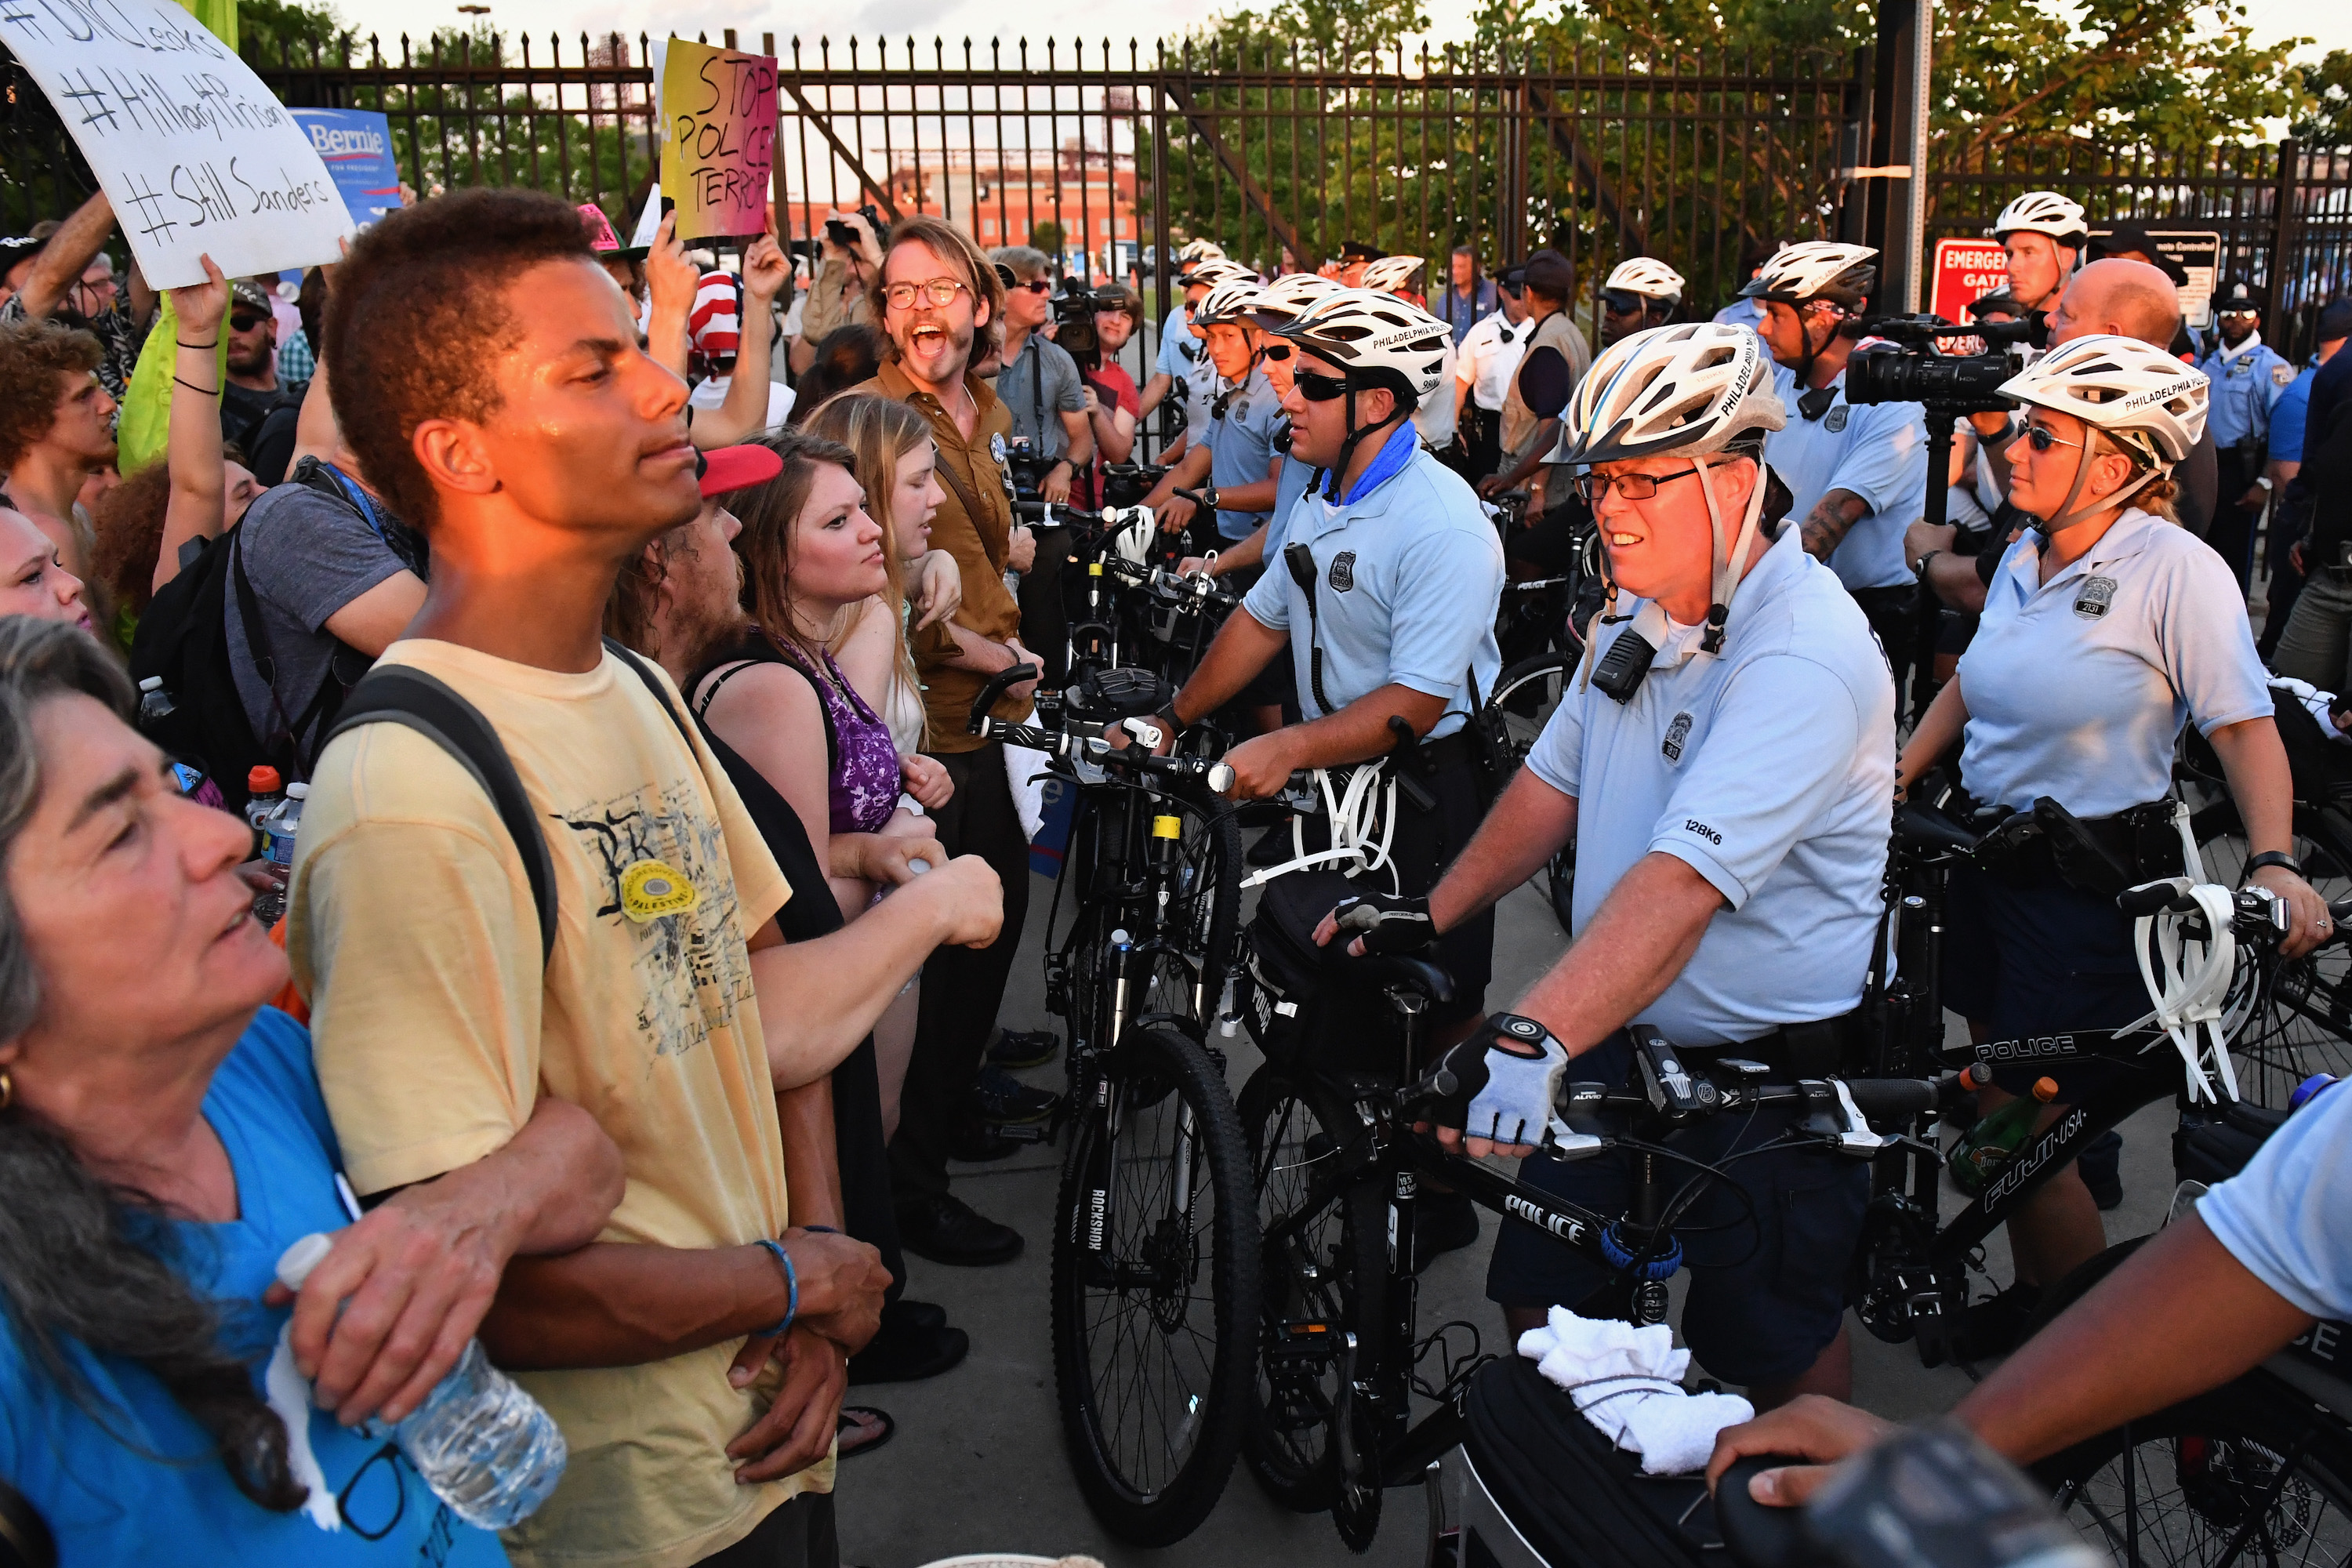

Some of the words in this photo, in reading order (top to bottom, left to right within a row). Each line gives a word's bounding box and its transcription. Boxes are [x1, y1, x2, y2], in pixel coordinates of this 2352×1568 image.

[696, 56, 772, 118] STOP
[308, 125, 384, 154] Bernie
[678, 115, 770, 167] POLICE
[691, 168, 766, 212] TERROR
[2176, 241, 2216, 252] Controlled
[1373, 325, 1430, 350] PHILADELPHIA
[2125, 380, 2191, 411] PHILADELPHIA
[1333, 576, 1349, 586] 9800
[2082, 603, 2100, 613] 2131
[1686, 818, 1722, 845] 12BK6
[632, 891, 688, 909] PALESTINE
[1976, 1036, 2078, 1062] POLICE
[1984, 1132, 2054, 1214] FUJI
[2060, 1109, 2084, 1145] USA
[1087, 1189, 1106, 1250] ROCKSHOX
[1504, 1193, 1586, 1246] POLICE
